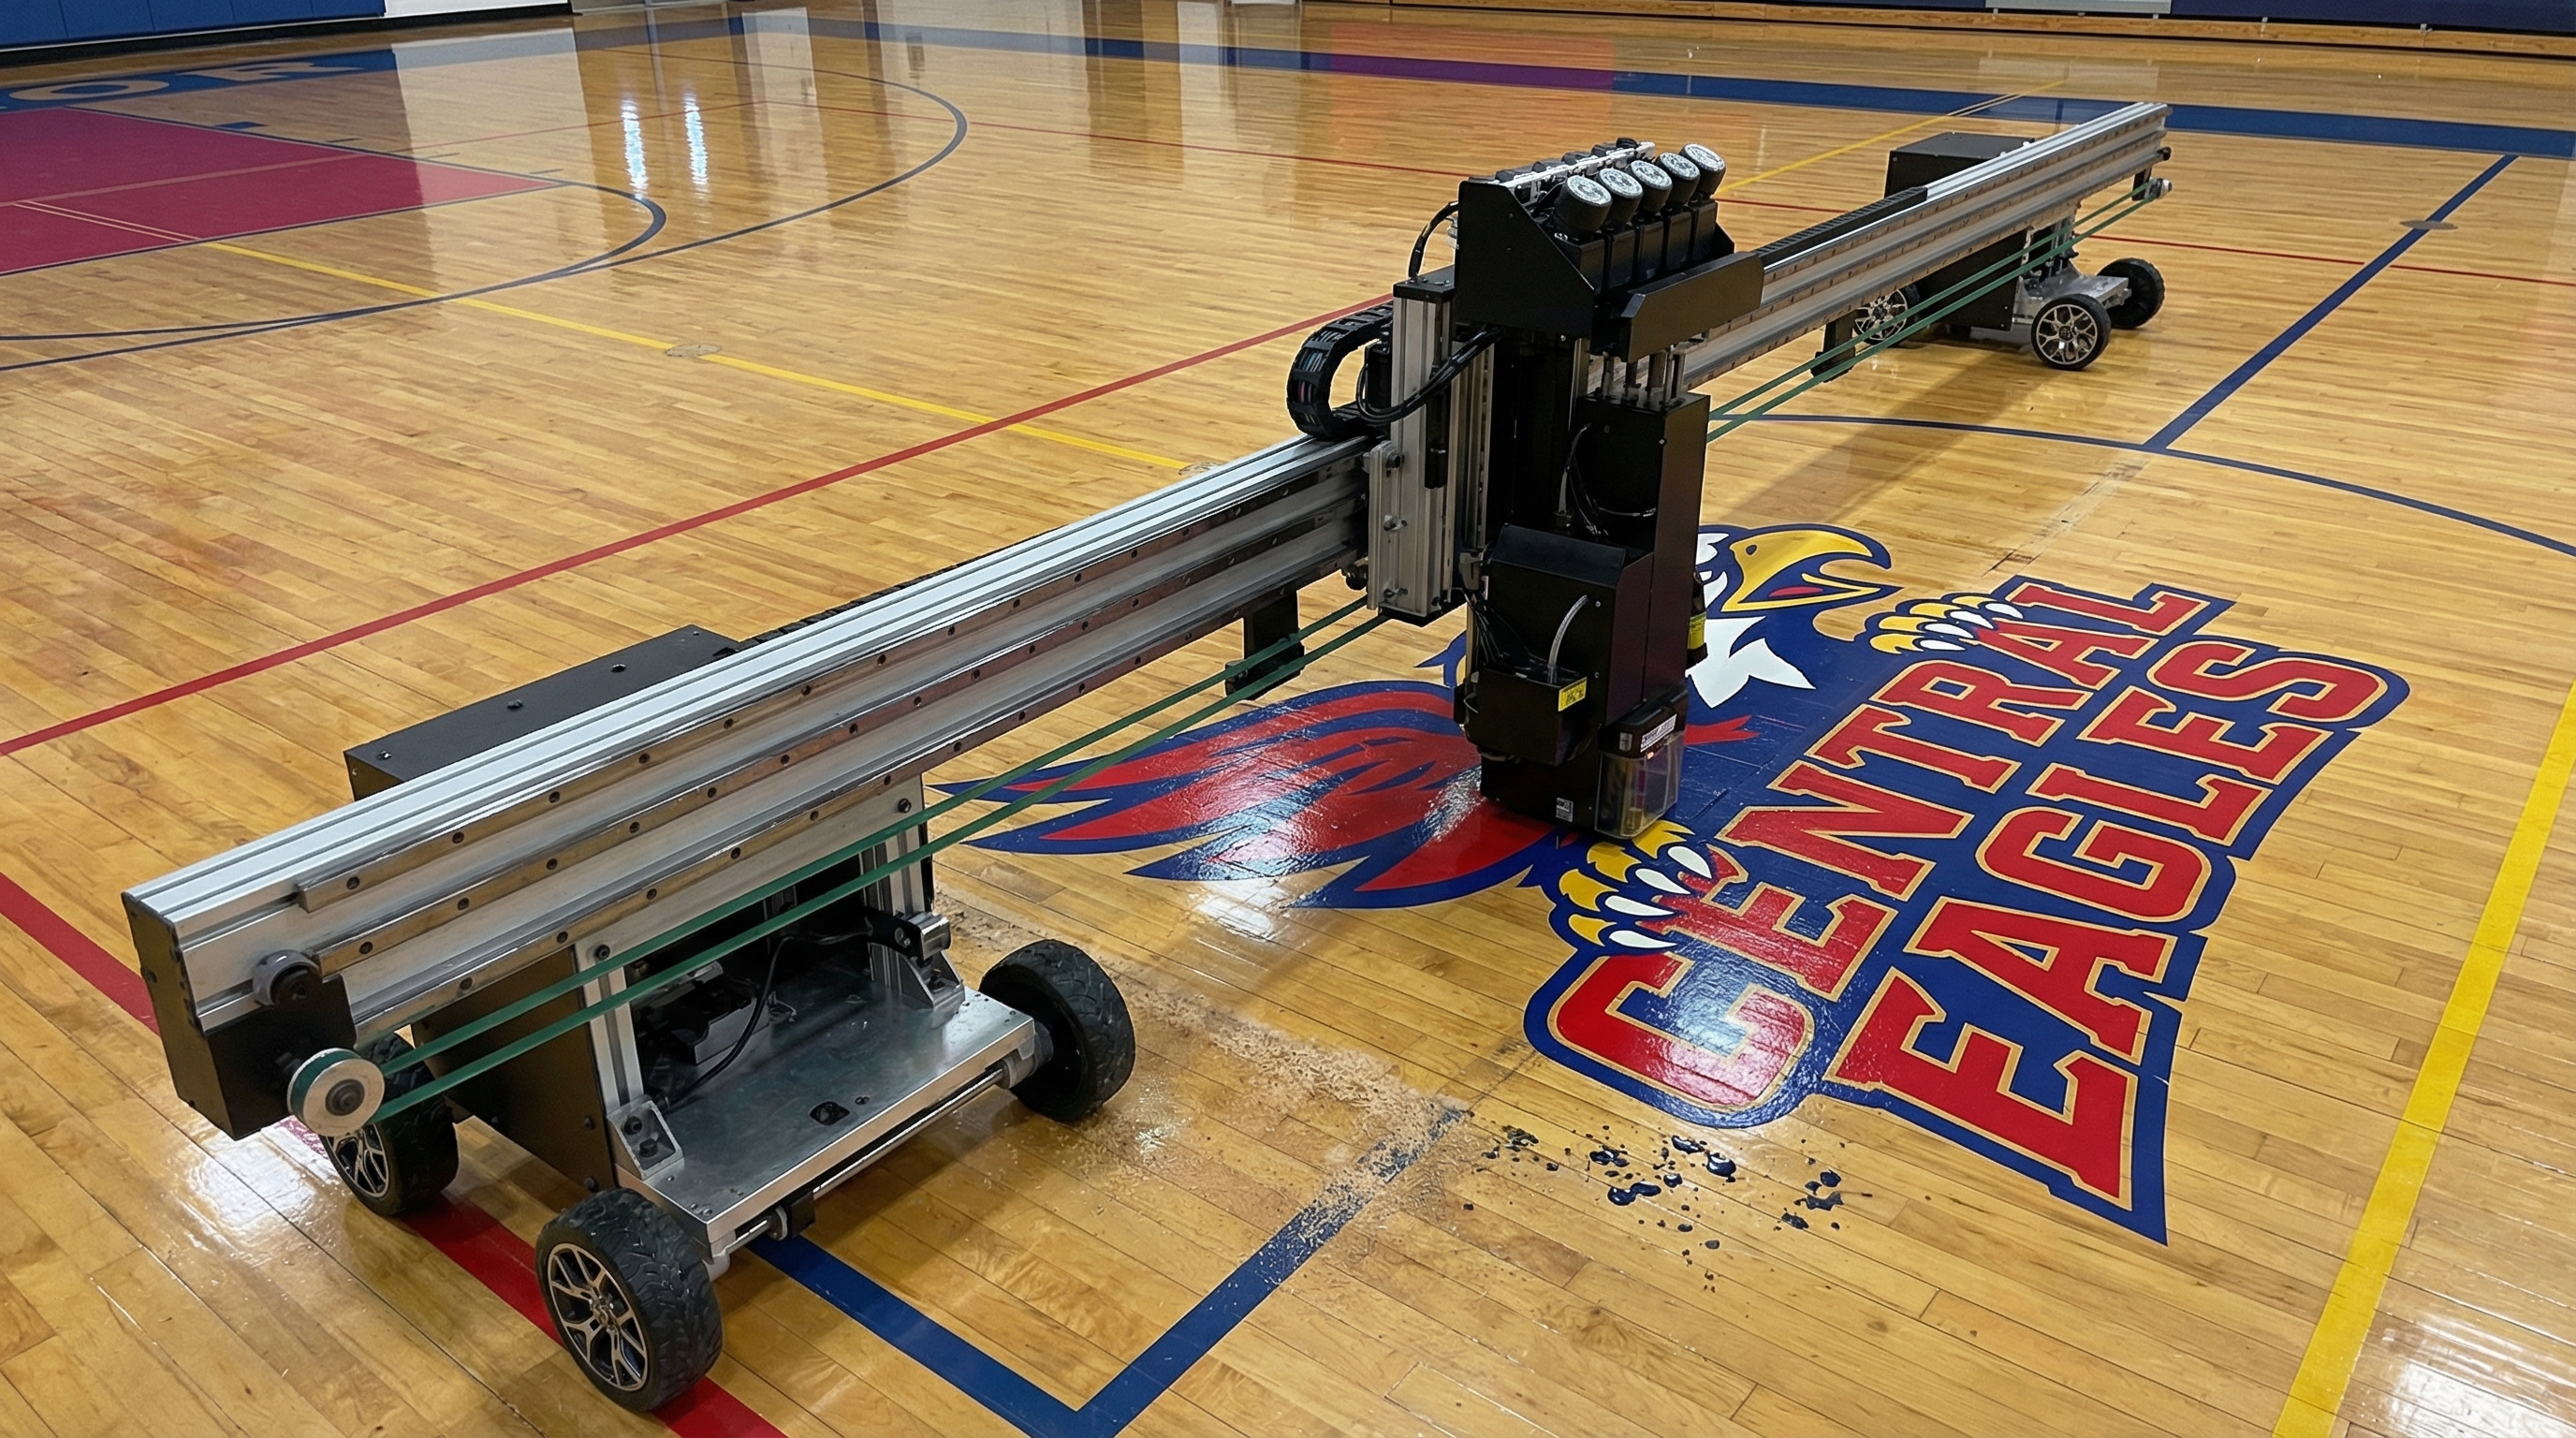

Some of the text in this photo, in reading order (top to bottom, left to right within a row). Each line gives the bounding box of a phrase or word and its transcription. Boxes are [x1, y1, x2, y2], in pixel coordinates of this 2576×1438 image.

[0, 61, 363, 109] OR
[1547, 575, 2210, 1112] CENTRAL
[1822, 640, 2389, 1211] EAGLES
